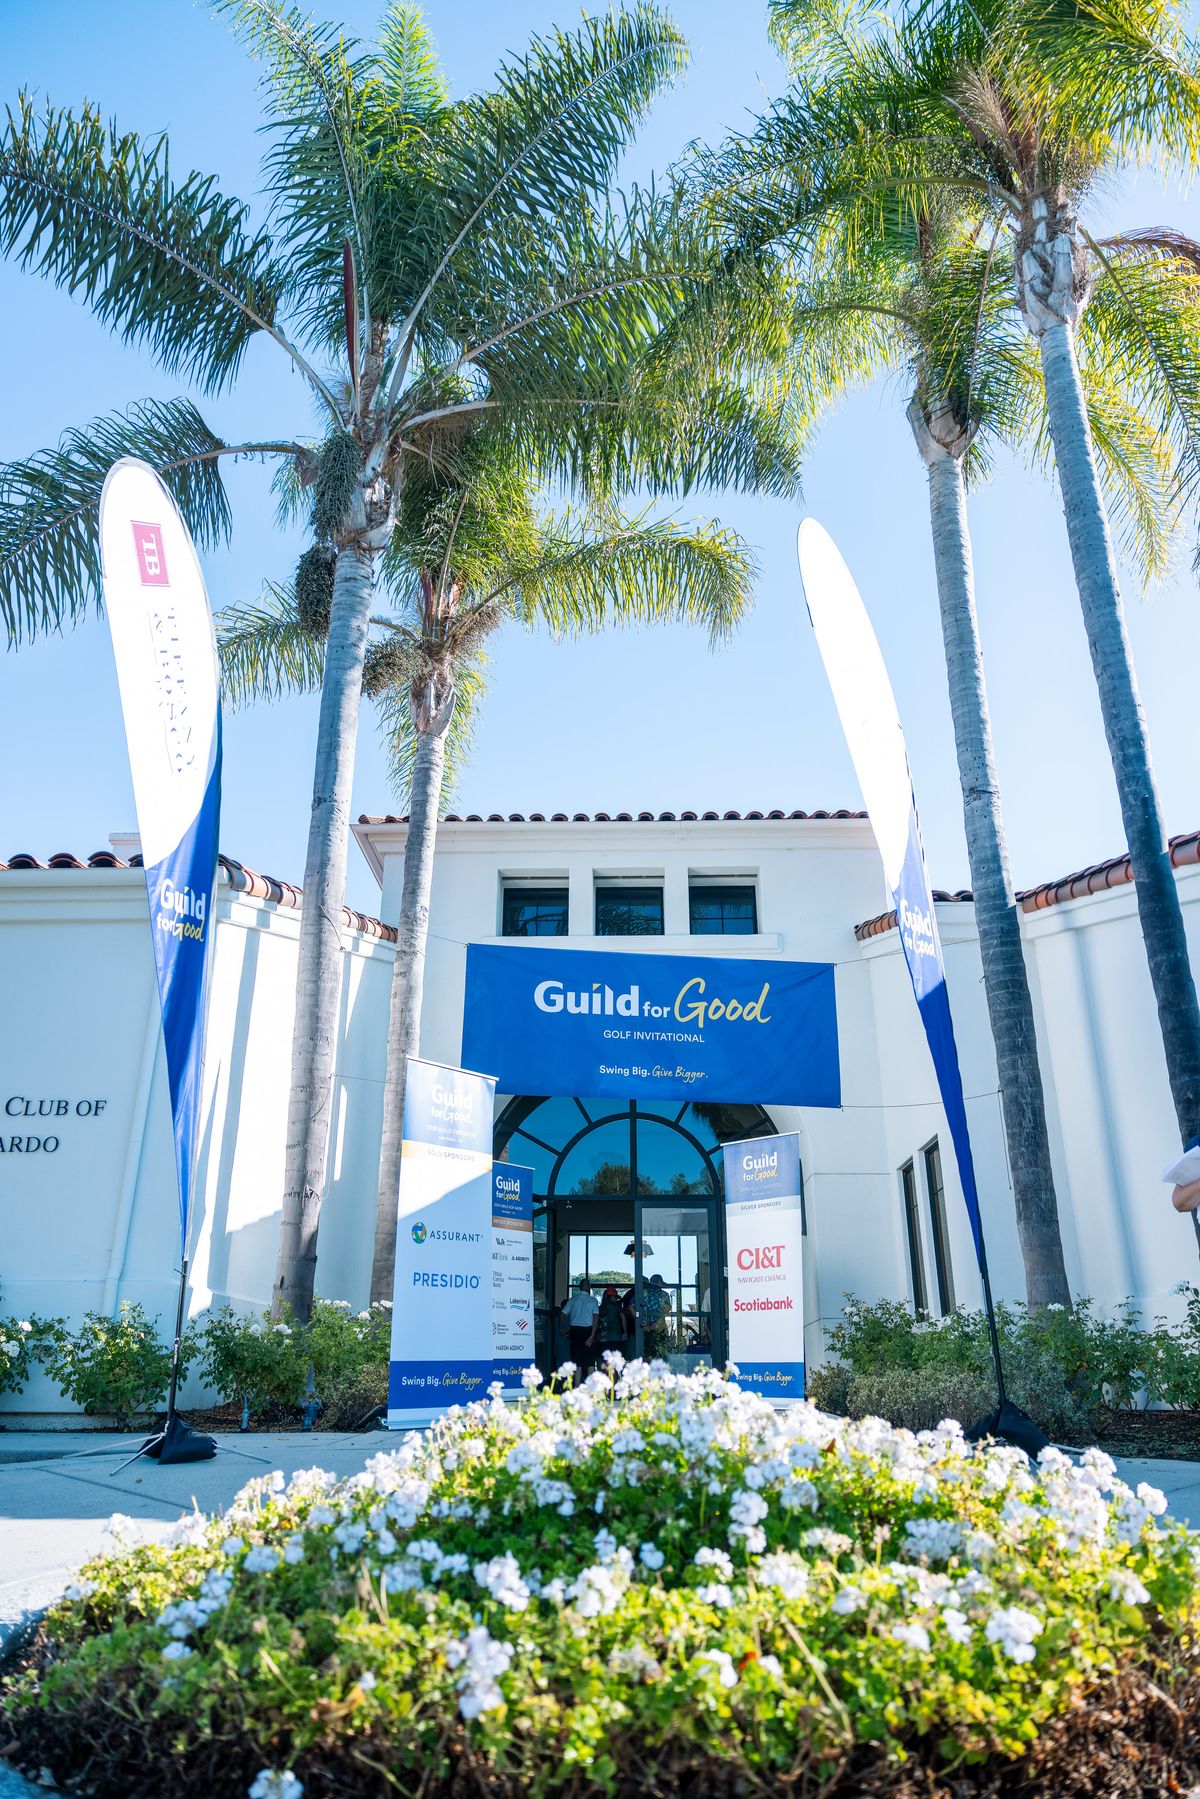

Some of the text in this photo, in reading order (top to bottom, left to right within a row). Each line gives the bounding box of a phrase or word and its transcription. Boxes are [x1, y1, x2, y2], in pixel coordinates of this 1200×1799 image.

[160, 878, 206, 920] Guild
[157, 910, 205, 942] for Good
[533, 977, 772, 1029] Guild for Good
[603, 1029, 705, 1043] GOLF INVITATIONAL
[599, 1065, 708, 1083] Swing Big. Give Bigger.
[5, 1096, 107, 1117] CLUB OF
[431, 1084, 473, 1111] Guild
[743, 1151, 778, 1171] Guild
[495, 1175, 520, 1192] Guild
[743, 1166, 777, 1182] for Good
[429, 1230, 481, 1243] ASSURANT
[737, 1245, 786, 1271] CI&T
[413, 1272, 480, 1289] PRESIDIO
[734, 1296, 793, 1312] Scotiabank
[401, 1372, 484, 1391] Swing Big. Give Bigger.
